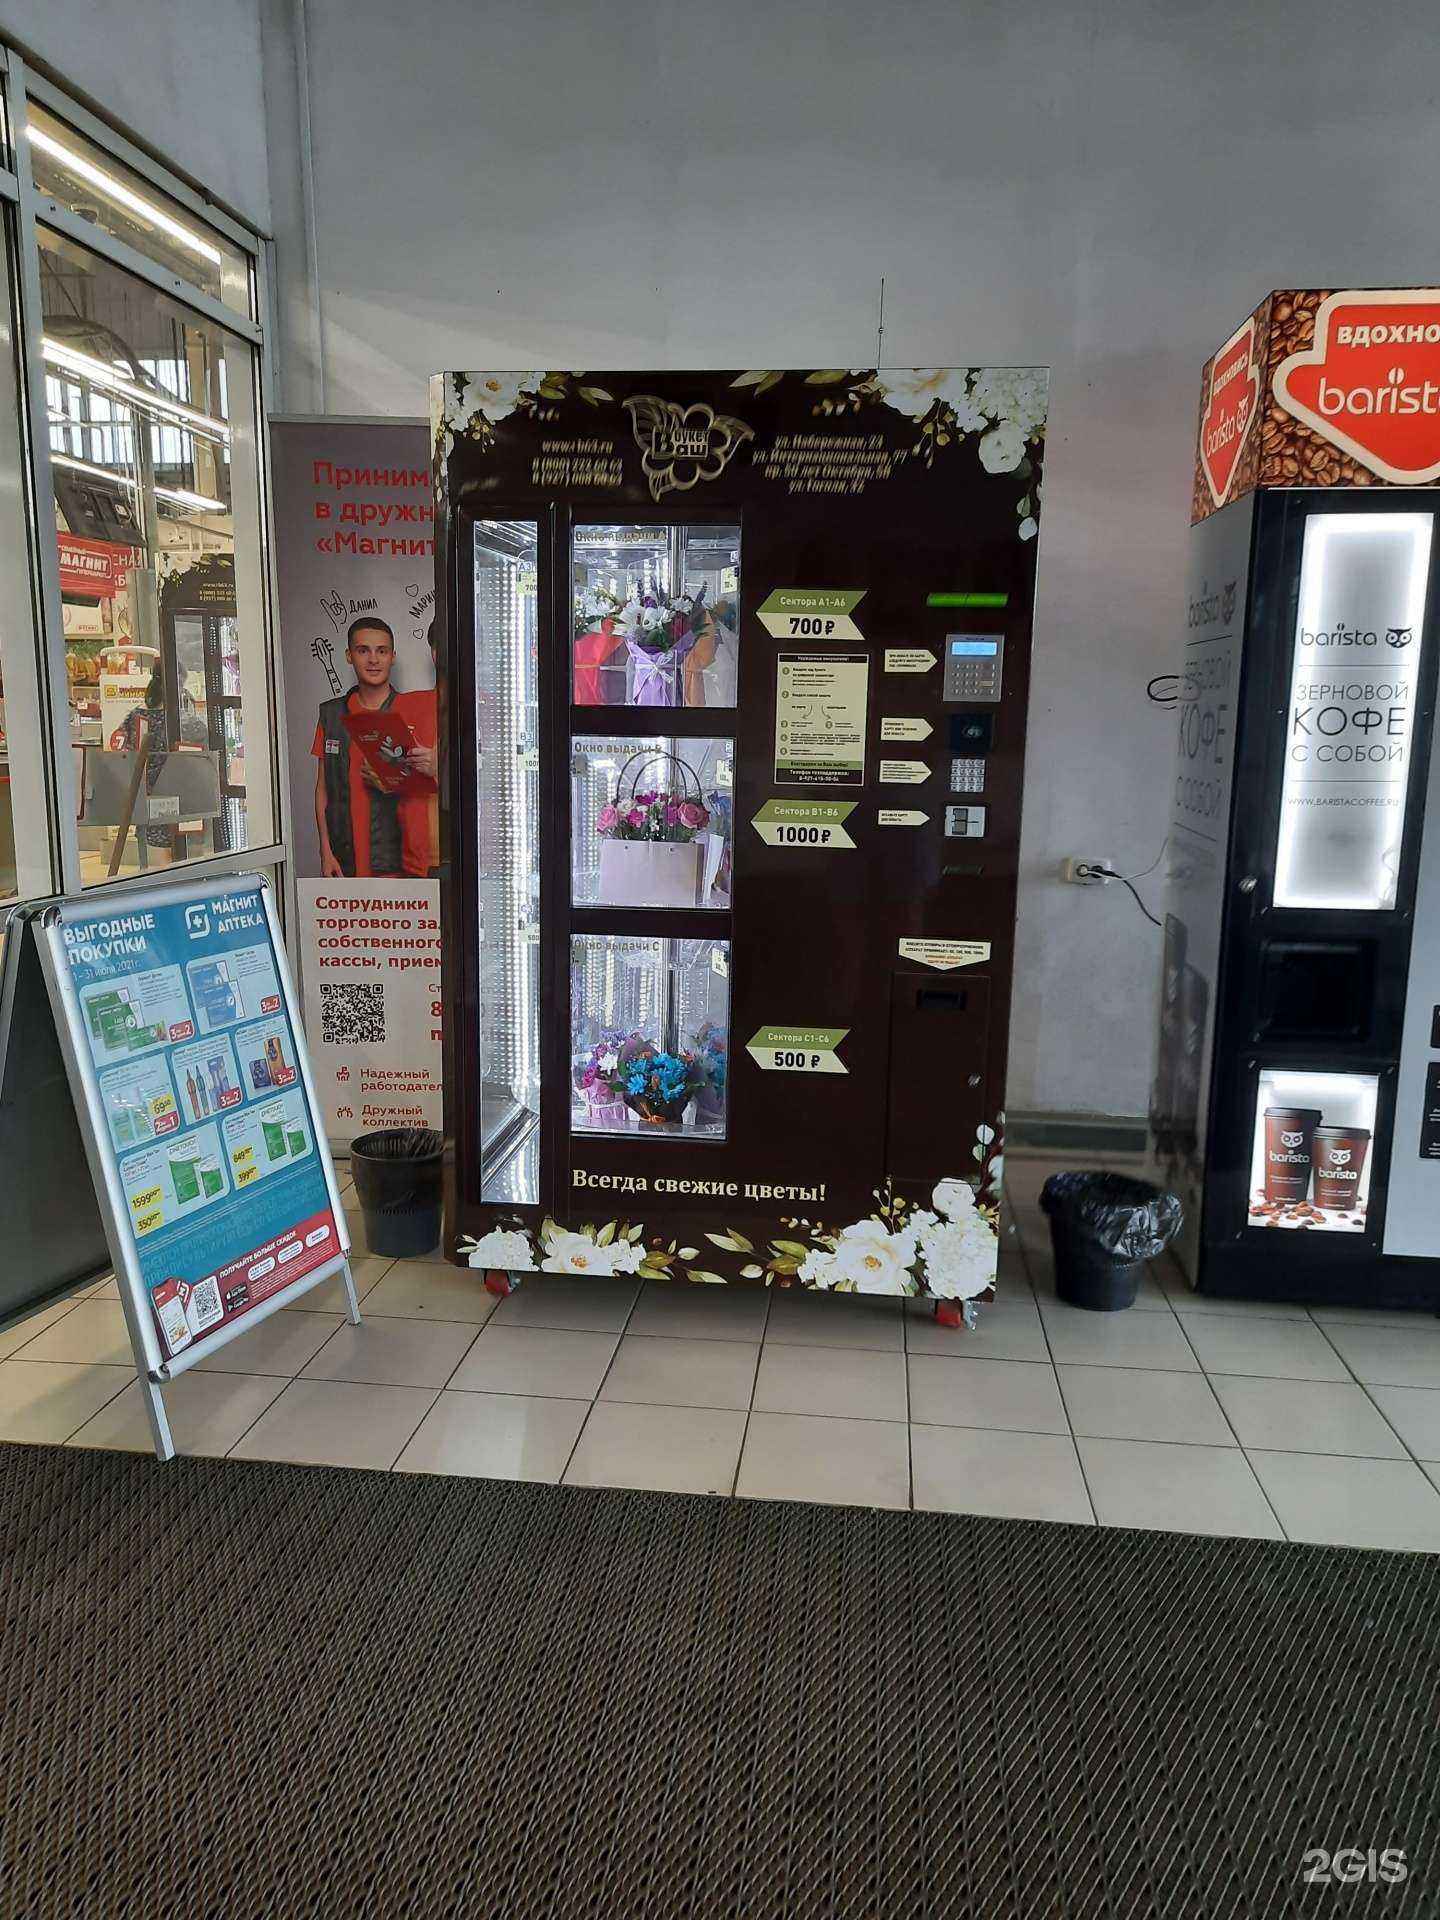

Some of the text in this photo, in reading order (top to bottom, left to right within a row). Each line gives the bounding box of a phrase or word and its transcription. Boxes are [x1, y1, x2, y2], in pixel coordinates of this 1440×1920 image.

[1318, 367, 1440, 415] barist
[313, 461, 433, 489] Приним
[315, 502, 331, 519] в
[780, 596, 817, 608] Сектора
[1300, 623, 1377, 646] barista
[1296, 682, 1408, 701] ЗЕРНОВОЙ
[1293, 707, 1406, 735] КОФЕ
[574, 742, 603, 753] Окно
[1291, 742, 1404, 762] С СОБОЙ
[774, 806, 810, 817] Сектора
[211, 894, 258, 915] МАГНИТ
[315, 896, 429, 913] Сотрудники
[63, 913, 155, 946] ВЫГОДНЫЕ
[218, 913, 264, 934] АПТЕКА
[316, 917, 441, 931] торгового за
[68, 936, 147, 965] ПОКУПКИ
[319, 956, 382, 970] кассы,
[767, 1033, 803, 1043] Сектора
[360, 1068, 430, 1080] Надежный
[362, 1104, 423, 1117] Дружный
[362, 1118, 429, 1128] коллектив
[1269, 1149, 1310, 1163] barista
[1318, 1166, 1358, 1180] barista
[572, 1169, 826, 1201] Всегда свежие цветы!
